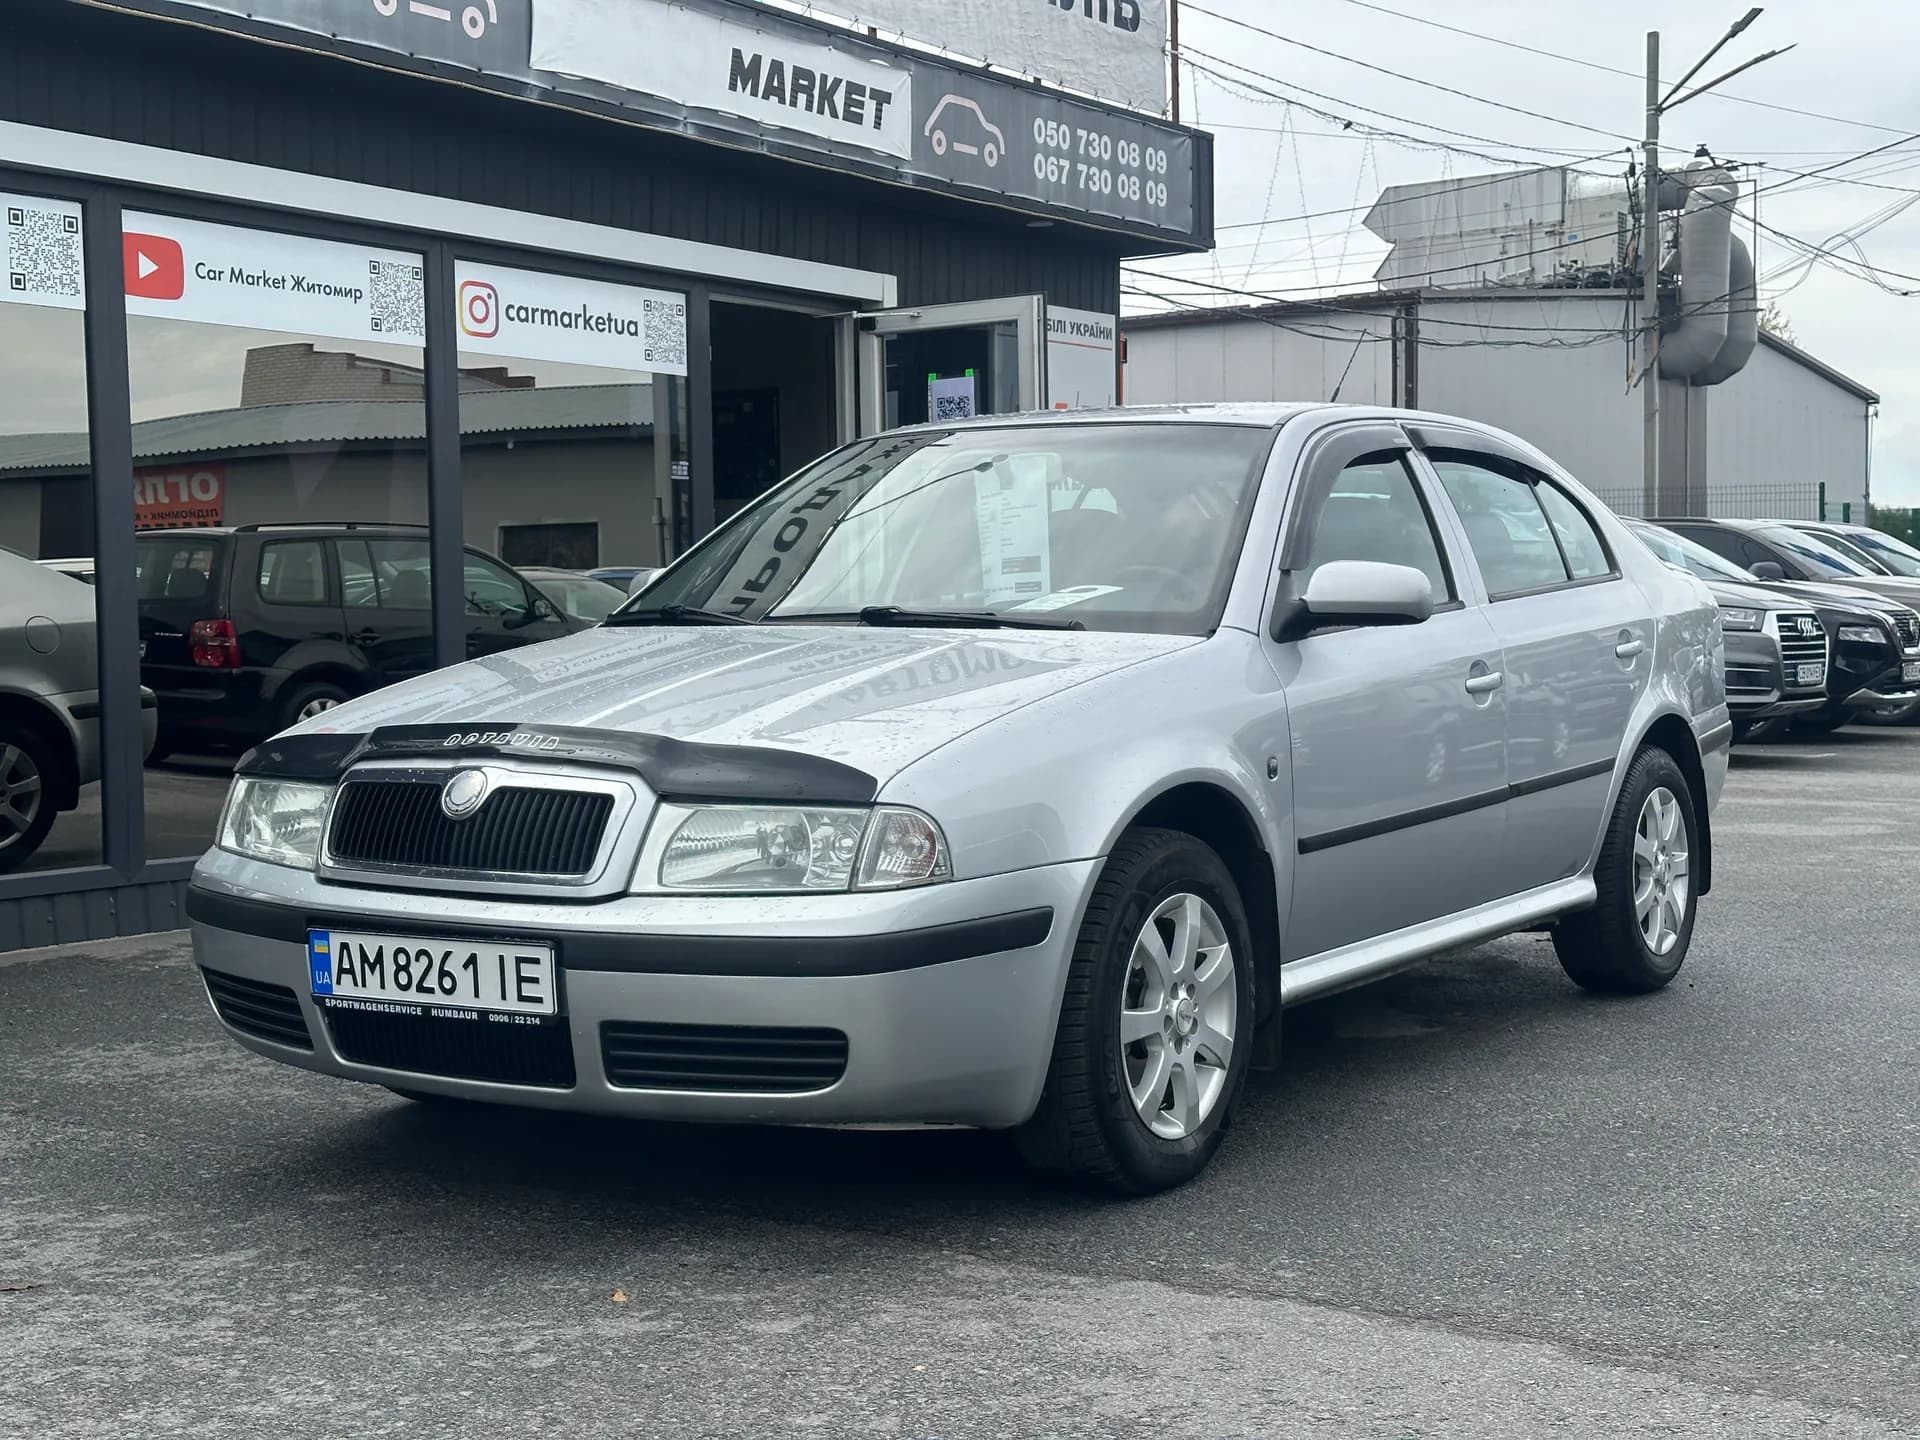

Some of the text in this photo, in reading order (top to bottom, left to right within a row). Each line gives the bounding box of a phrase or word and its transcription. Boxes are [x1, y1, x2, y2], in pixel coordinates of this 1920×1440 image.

[728, 47, 892, 130] MARKET
[1033, 117, 1167, 174] 050 730 08 09
[1033, 152, 1167, 207] 067 730 08 09
[195, 262, 363, 304] Car Market Житомир
[505, 303, 639, 337] carmarketua
[1069, 320, 1113, 341] УКРАЇНИ
[443, 732, 560, 749] OCTAVIA
[315, 970, 331, 985] UA
[325, 998, 423, 1016] SPORTWAGENSERVICE
[431, 1008, 478, 1021] HUMBAUR
